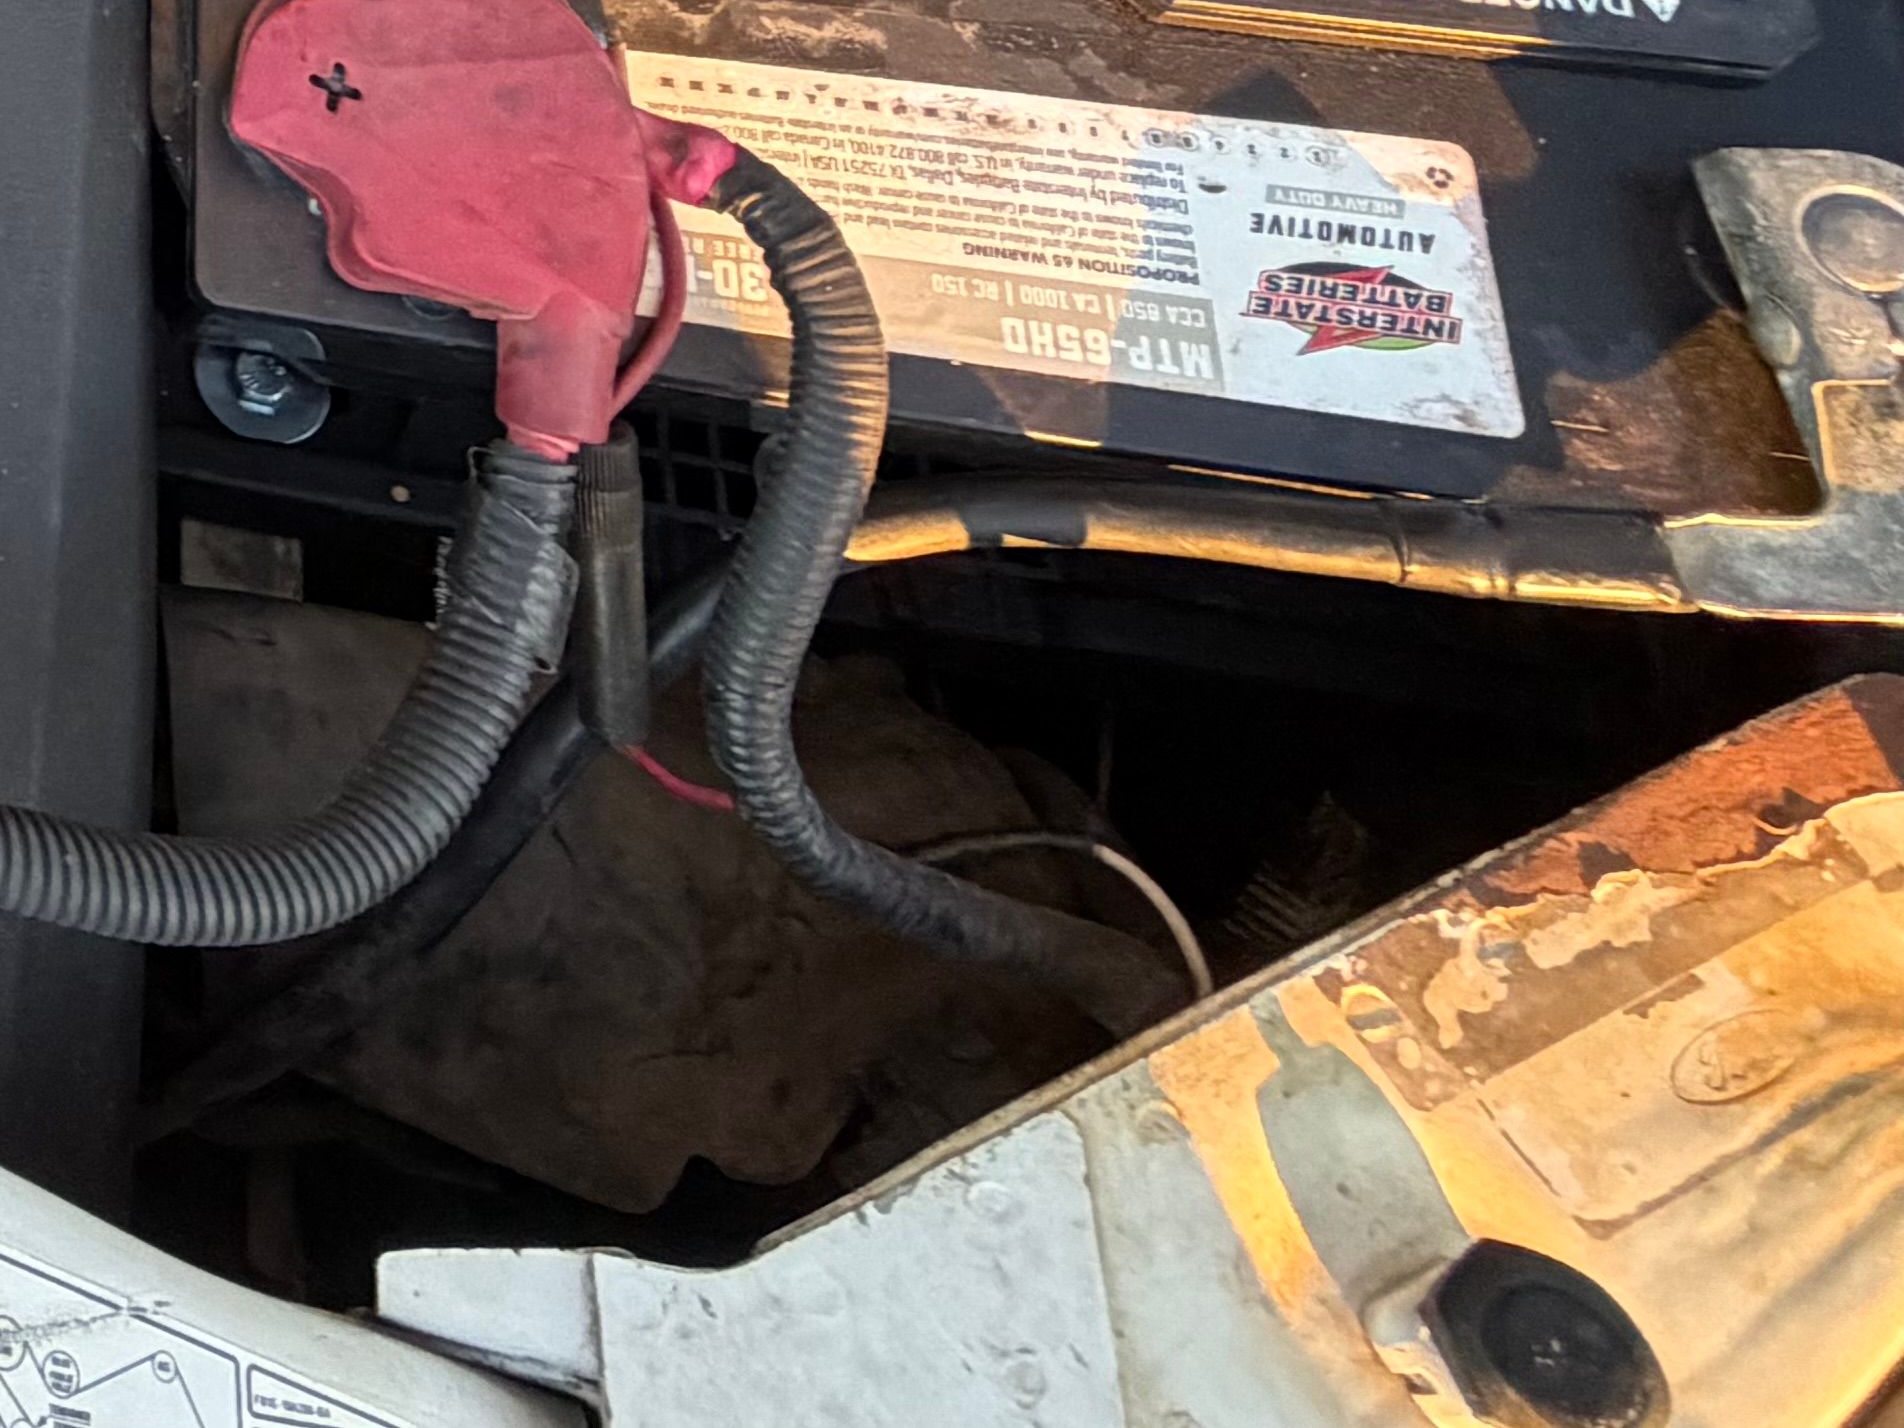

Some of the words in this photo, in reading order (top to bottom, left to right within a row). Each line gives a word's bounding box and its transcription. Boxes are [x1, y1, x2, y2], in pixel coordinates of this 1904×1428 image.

[782, 131, 829, 149] Canada
[807, 155, 838, 170] USA
[946, 151, 967, 165] call
[1169, 177, 1187, 192] To
[1273, 186, 1325, 206] DUTY
[1330, 193, 1399, 216] HEAVY
[1248, 211, 1434, 254] AUTOMOTIVE
[962, 242, 1048, 264] WARNING
[1052, 253, 1072, 267] 65
[1076, 256, 1199, 284] PROPOSITION
[929, 272, 967, 295] 150
[969, 278, 998, 299] RC
[1260, 272, 1447, 313] BATTERIES
[1017, 284, 1068, 309] 1000
[1069, 291, 1102, 313] CA
[1164, 304, 1206, 328] CCA
[1249, 295, 1460, 340] INTERSTATE
[997, 313, 1211, 382] MTP-65HD
